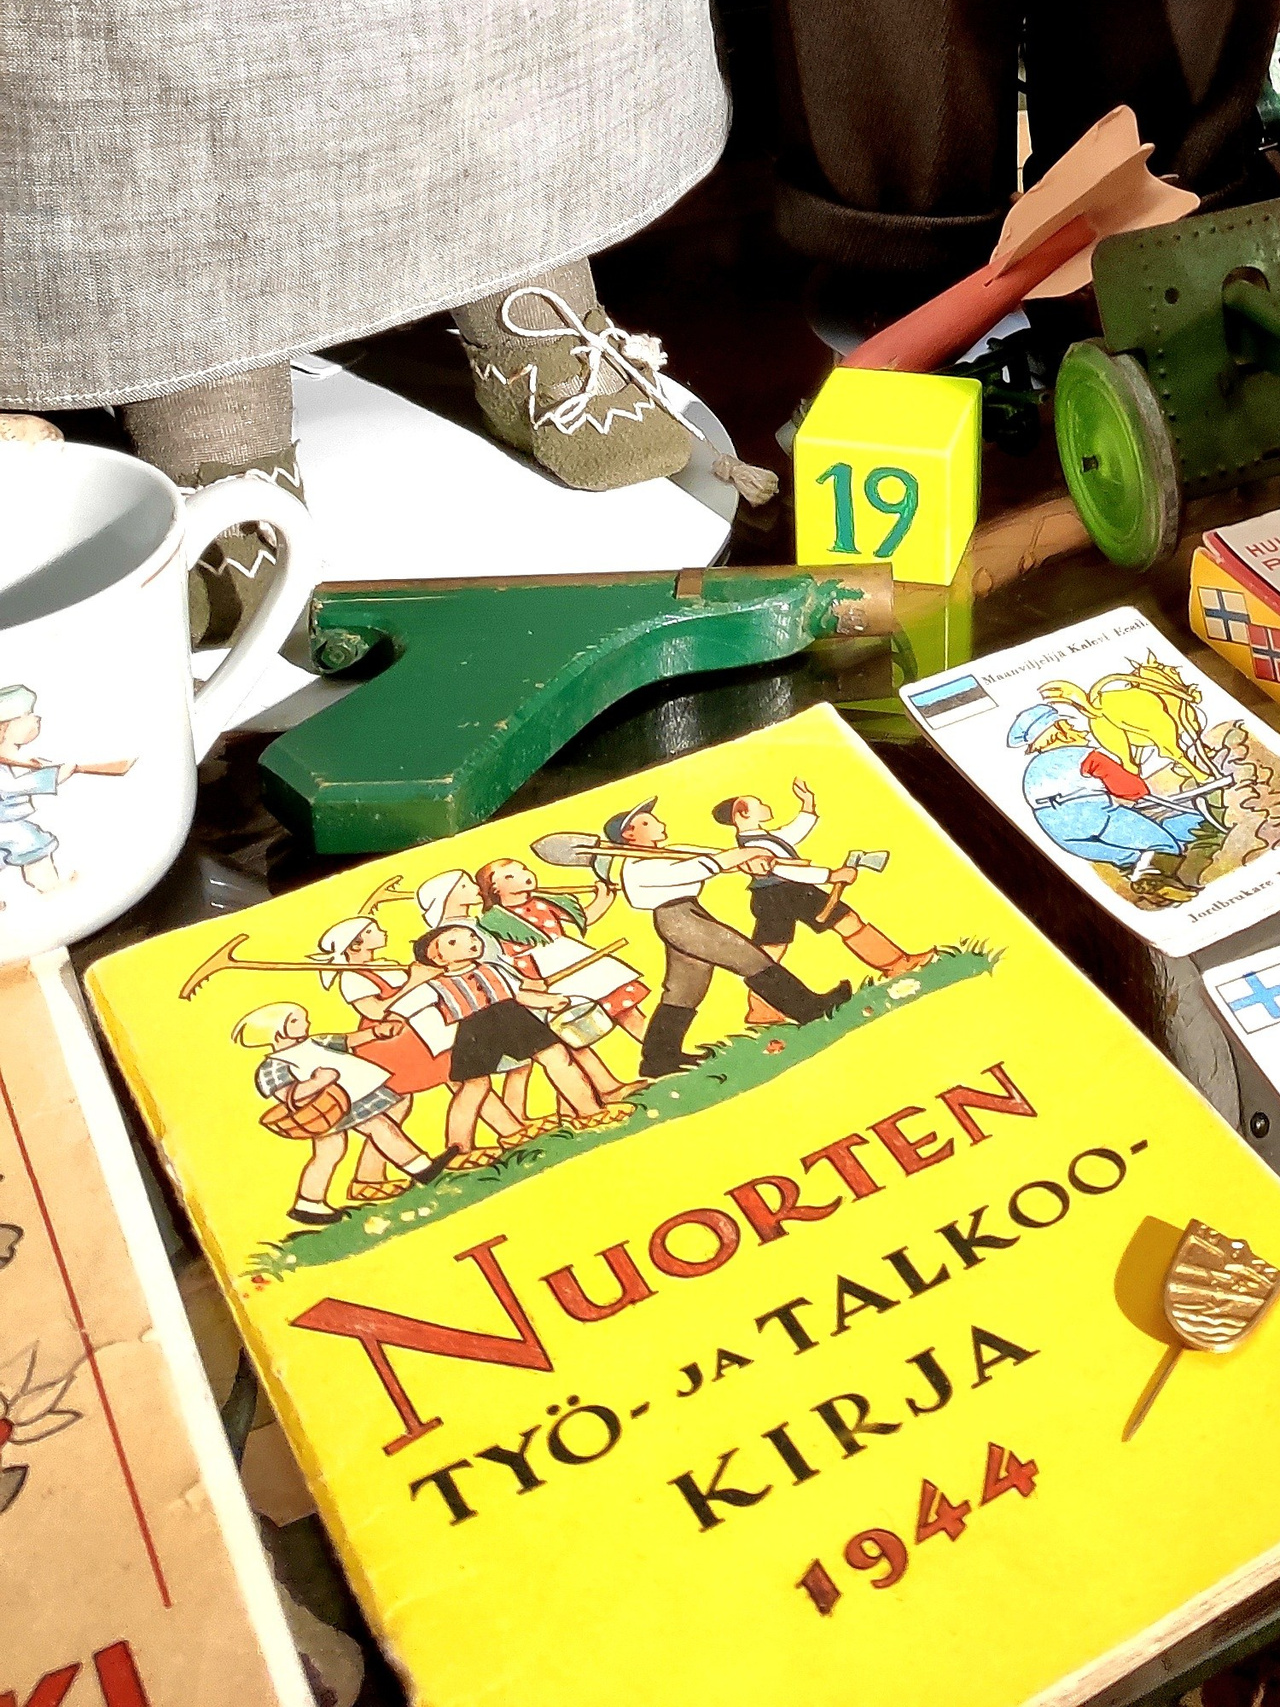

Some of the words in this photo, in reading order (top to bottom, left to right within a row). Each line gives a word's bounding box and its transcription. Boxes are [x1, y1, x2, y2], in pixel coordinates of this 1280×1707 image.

[815, 461, 919, 558] 19
[981, 649, 1066, 685] Maanviljelijä
[1066, 632, 1111, 653] Kalevi
[1187, 879, 1274, 923] Jordbrukare
[291, 1061, 1038, 1456] NUORTEN
[410, 1396, 651, 1528] TYÖ-
[677, 1347, 755, 1400] JA
[755, 1137, 1151, 1357] TALKOO-
[667, 1325, 1041, 1534] KIRJA
[795, 1441, 1041, 1619] 1944
